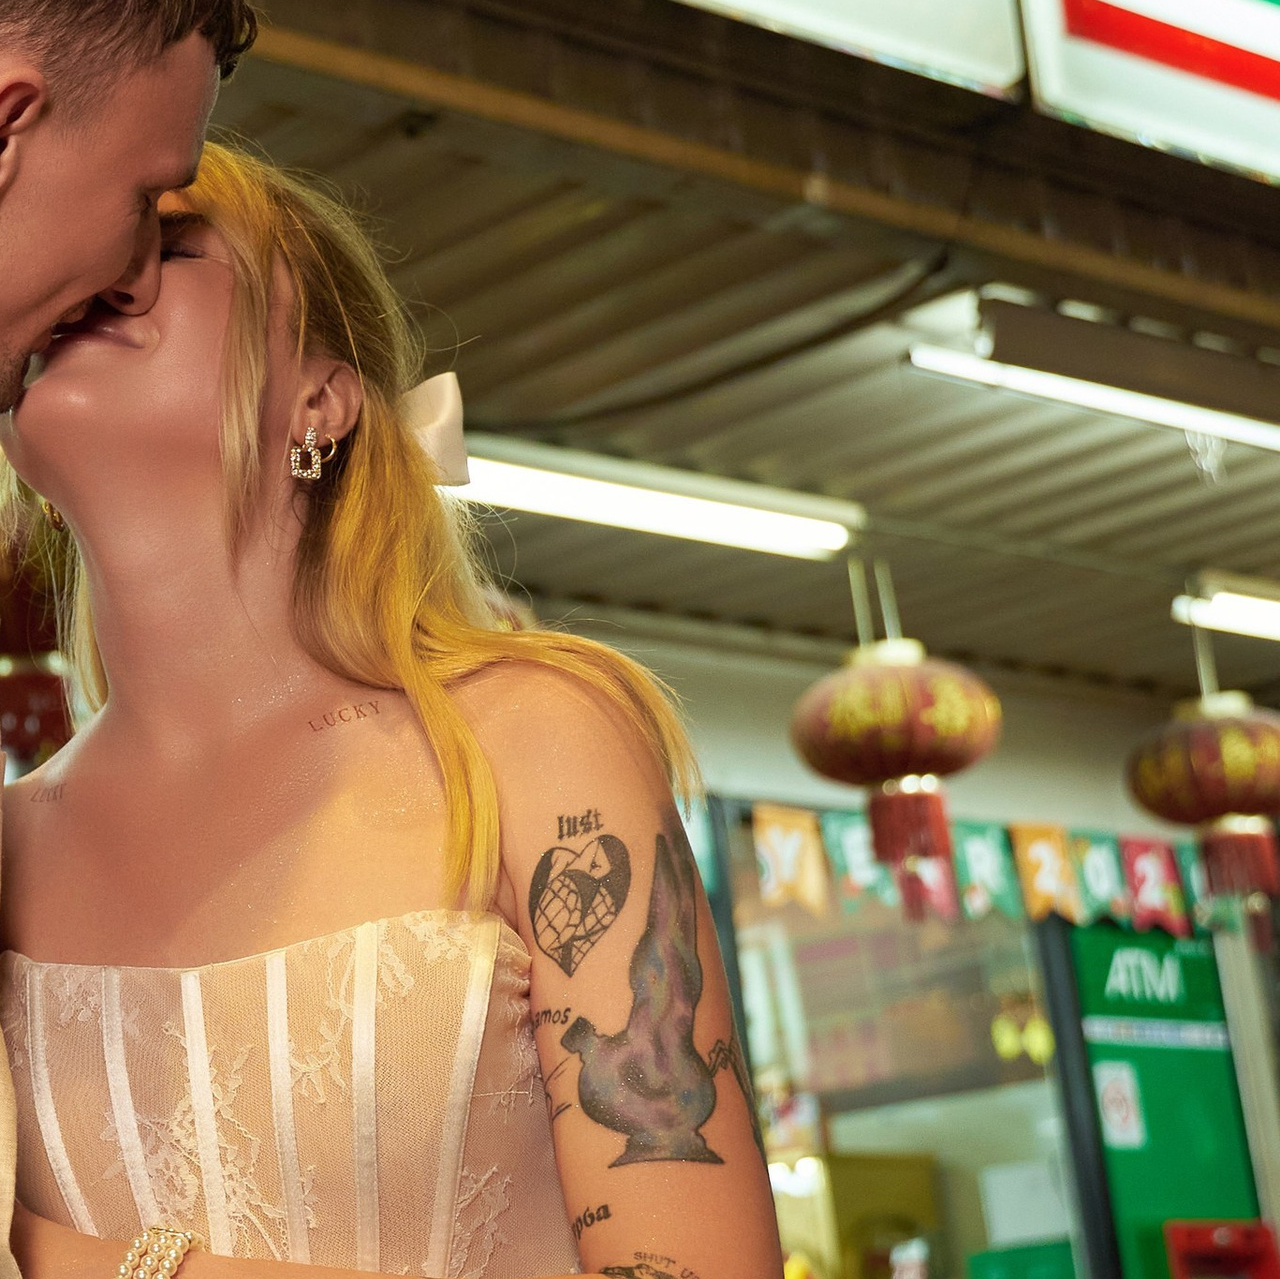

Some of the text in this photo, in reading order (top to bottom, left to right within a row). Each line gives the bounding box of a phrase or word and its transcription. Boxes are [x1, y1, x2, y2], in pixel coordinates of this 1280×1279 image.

[308, 700, 381, 732] LUCKY
[766, 824, 1210, 910] YER 202
[1104, 946, 1186, 1005] ATM
[634, 1252, 676, 1269] SHUT
